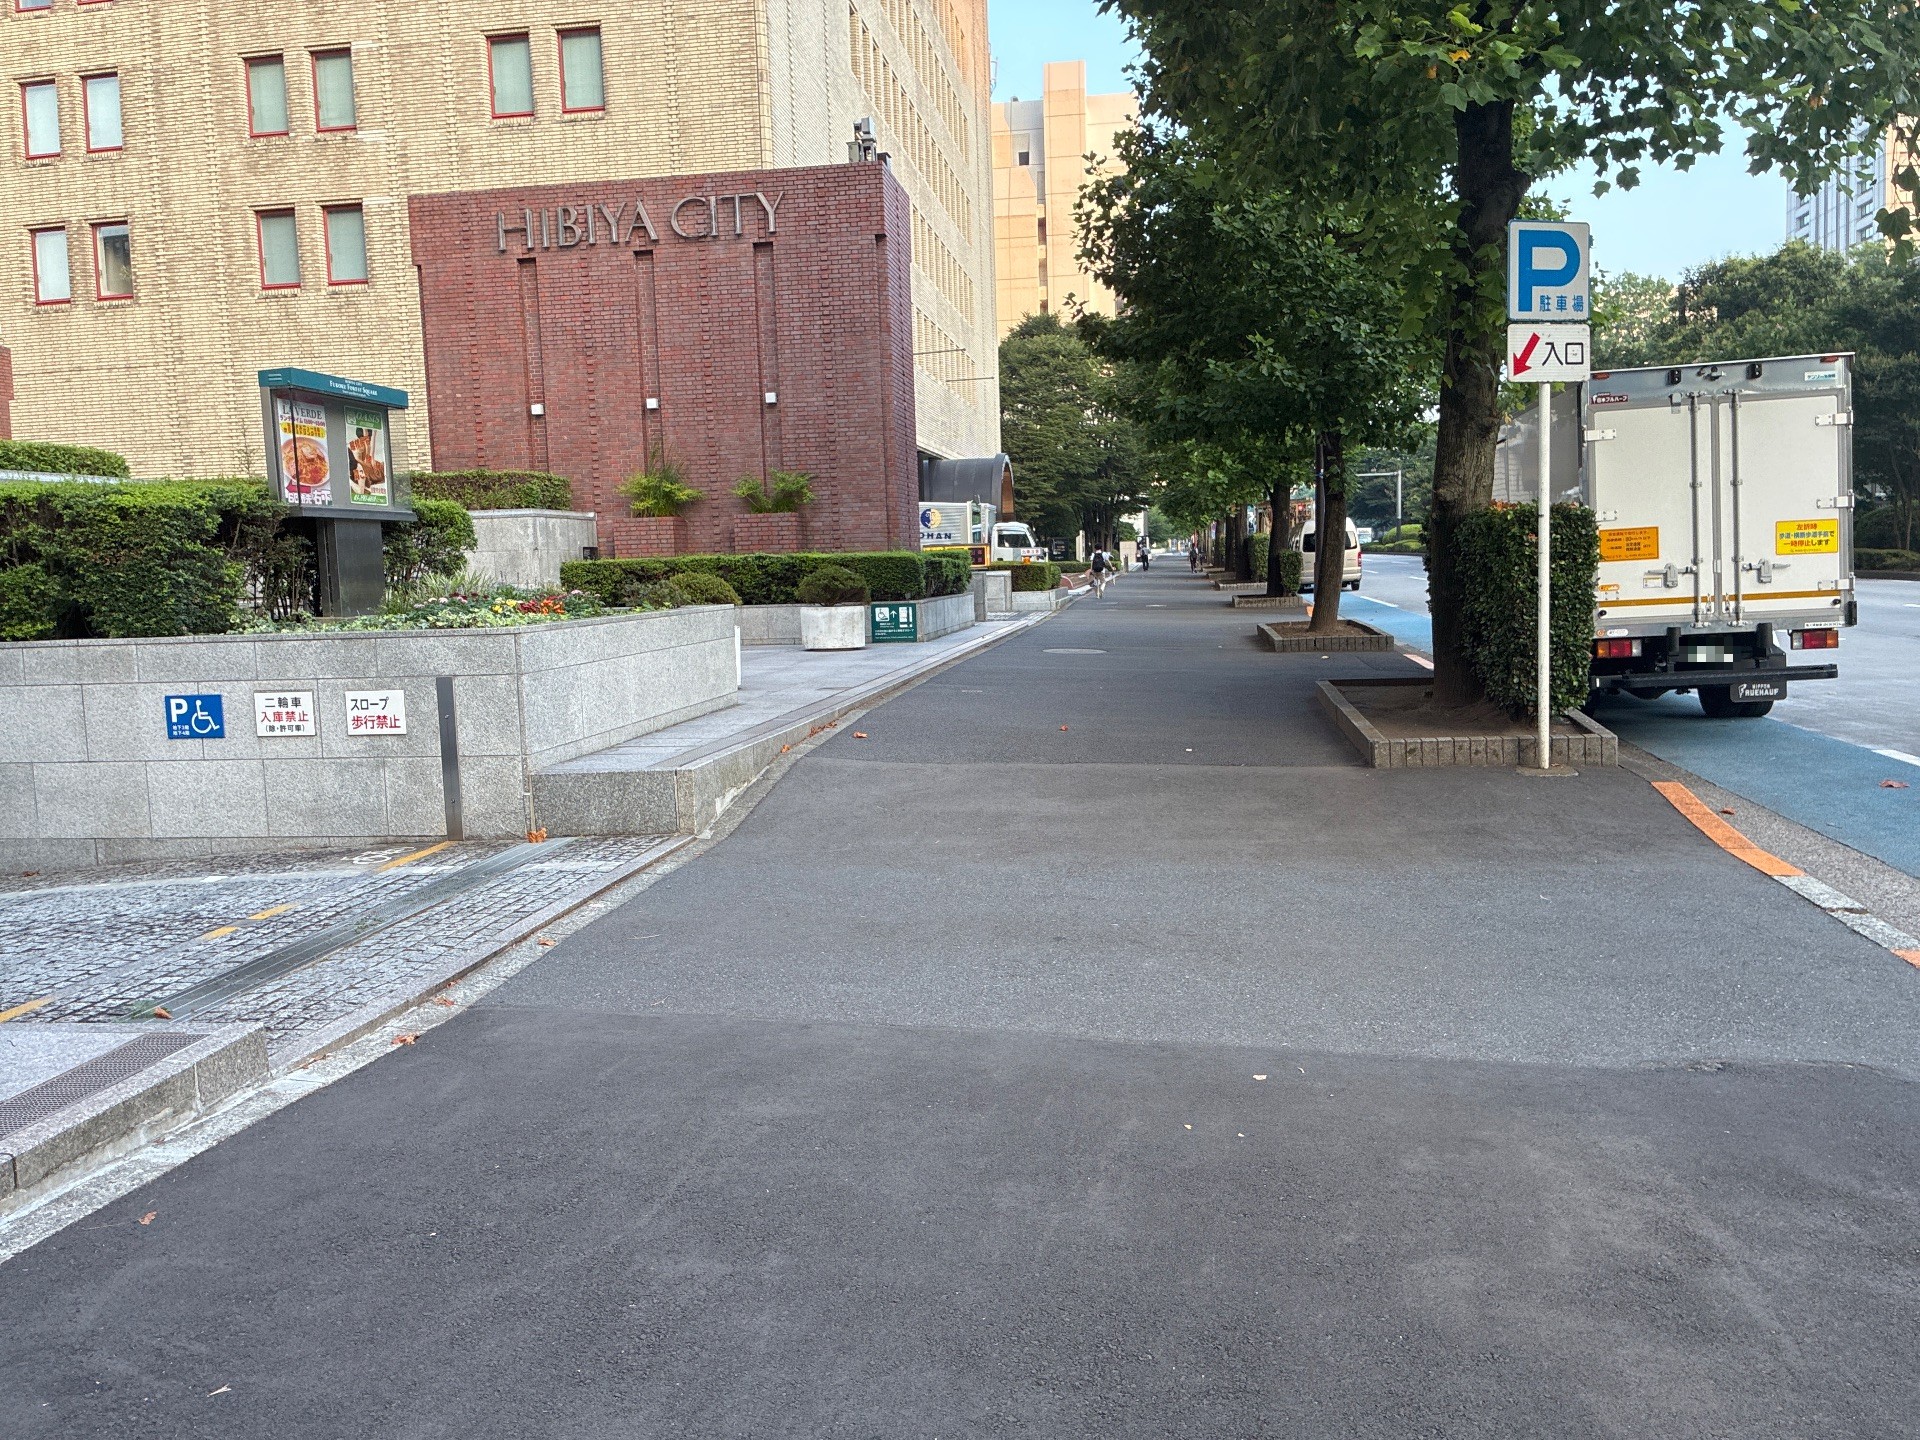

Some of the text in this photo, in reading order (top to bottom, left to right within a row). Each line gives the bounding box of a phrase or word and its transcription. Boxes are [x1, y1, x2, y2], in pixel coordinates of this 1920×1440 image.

[497, 191, 784, 251] HIBIYA CITY
[1518, 230, 1580, 312] P
[1539, 295, 1584, 312] 駐車場
[1542, 342, 1584, 366] 入口
[294, 406, 323, 419] VERDE
[1783, 538, 1831, 547] 一時停止します
[170, 698, 188, 723] P
[264, 696, 302, 709] 二輪車
[350, 695, 390, 711] スロープ
[260, 710, 310, 723] 入庫禁止
[351, 714, 402, 730] 歩行禁止
